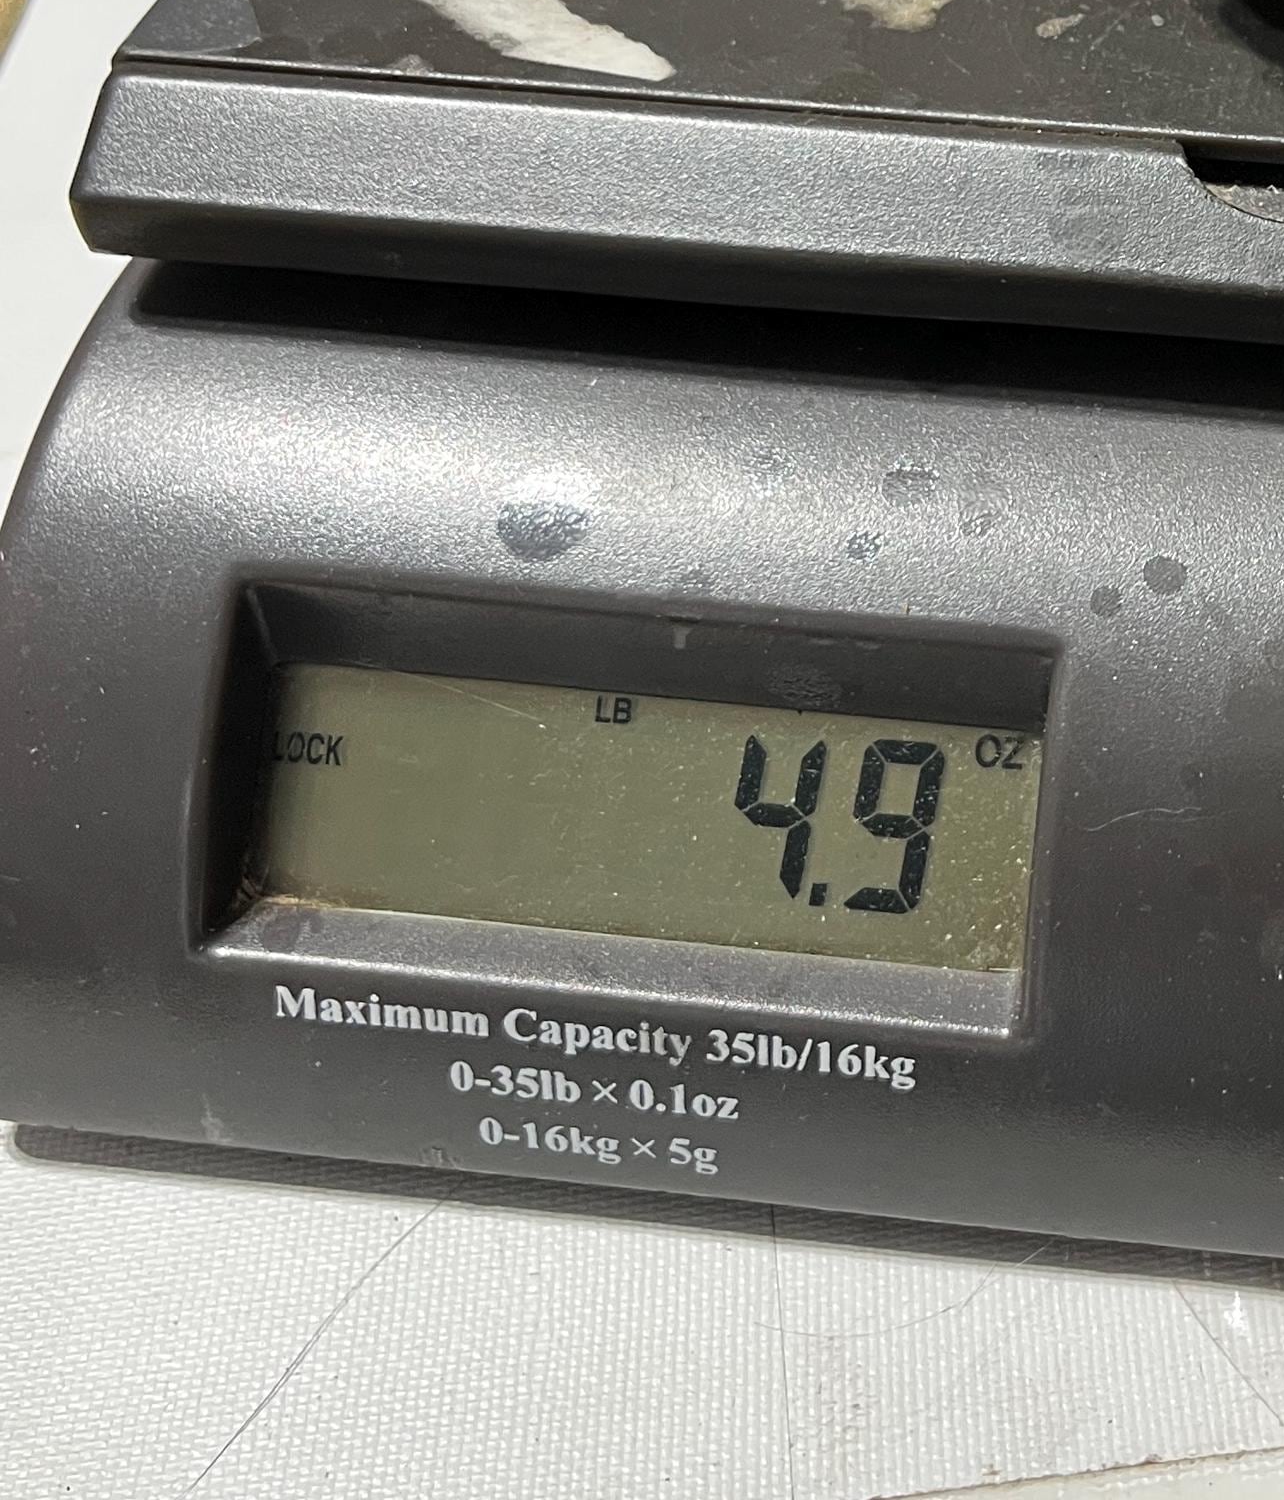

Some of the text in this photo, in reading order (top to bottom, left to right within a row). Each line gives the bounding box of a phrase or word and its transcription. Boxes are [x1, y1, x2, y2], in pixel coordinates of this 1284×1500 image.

[594, 695, 633, 724] LB
[273, 731, 343, 766] LOCK
[734, 734, 1024, 914] 4.9 OZ
[274, 984, 917, 1090] Maximum Capacity 35lb/16kg
[450, 1061, 582, 1103] 0-35lb
[628, 1077, 740, 1121] 0.1oz
[479, 1117, 622, 1163] 0-16kg
[668, 1137, 719, 1175] 5g
